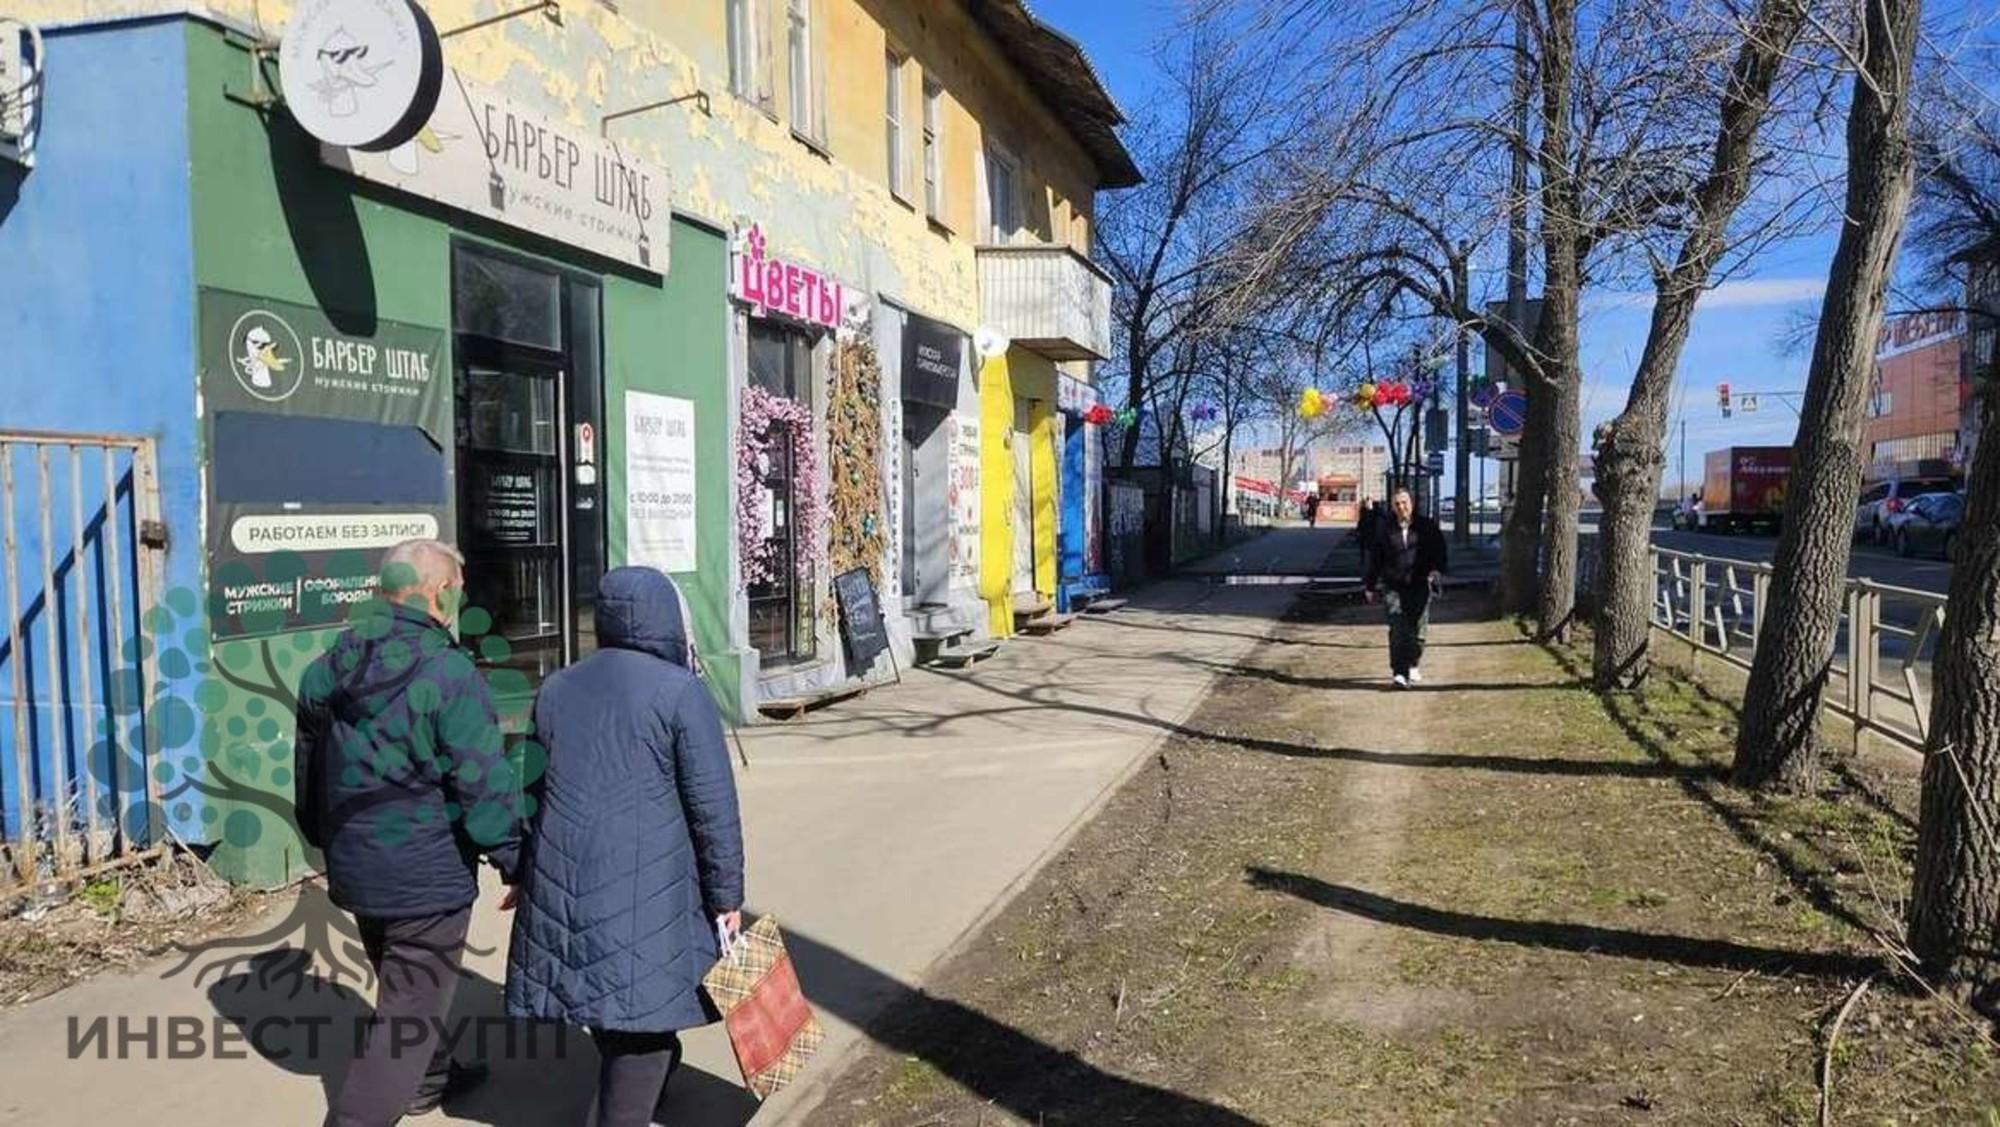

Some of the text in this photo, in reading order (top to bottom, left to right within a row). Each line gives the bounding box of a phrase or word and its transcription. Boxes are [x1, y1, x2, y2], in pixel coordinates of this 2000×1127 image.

[485, 103, 651, 220] БАРБЕР ШТАБ
[509, 186, 573, 220] ужские
[742, 254, 841, 327] ЦВЕТЫ
[311, 336, 430, 382] БАРБЕР ШТАБ
[249, 523, 426, 542] РАБОТАЕМ БЕЗ ЗАПИСИ
[224, 582, 294, 599] МУЖСКИЕ
[303, 576, 382, 593] ОФОРМЛЕНИ
[225, 597, 293, 615] СТРИЖКИ
[321, 589, 373, 605] БОРОДЫ
